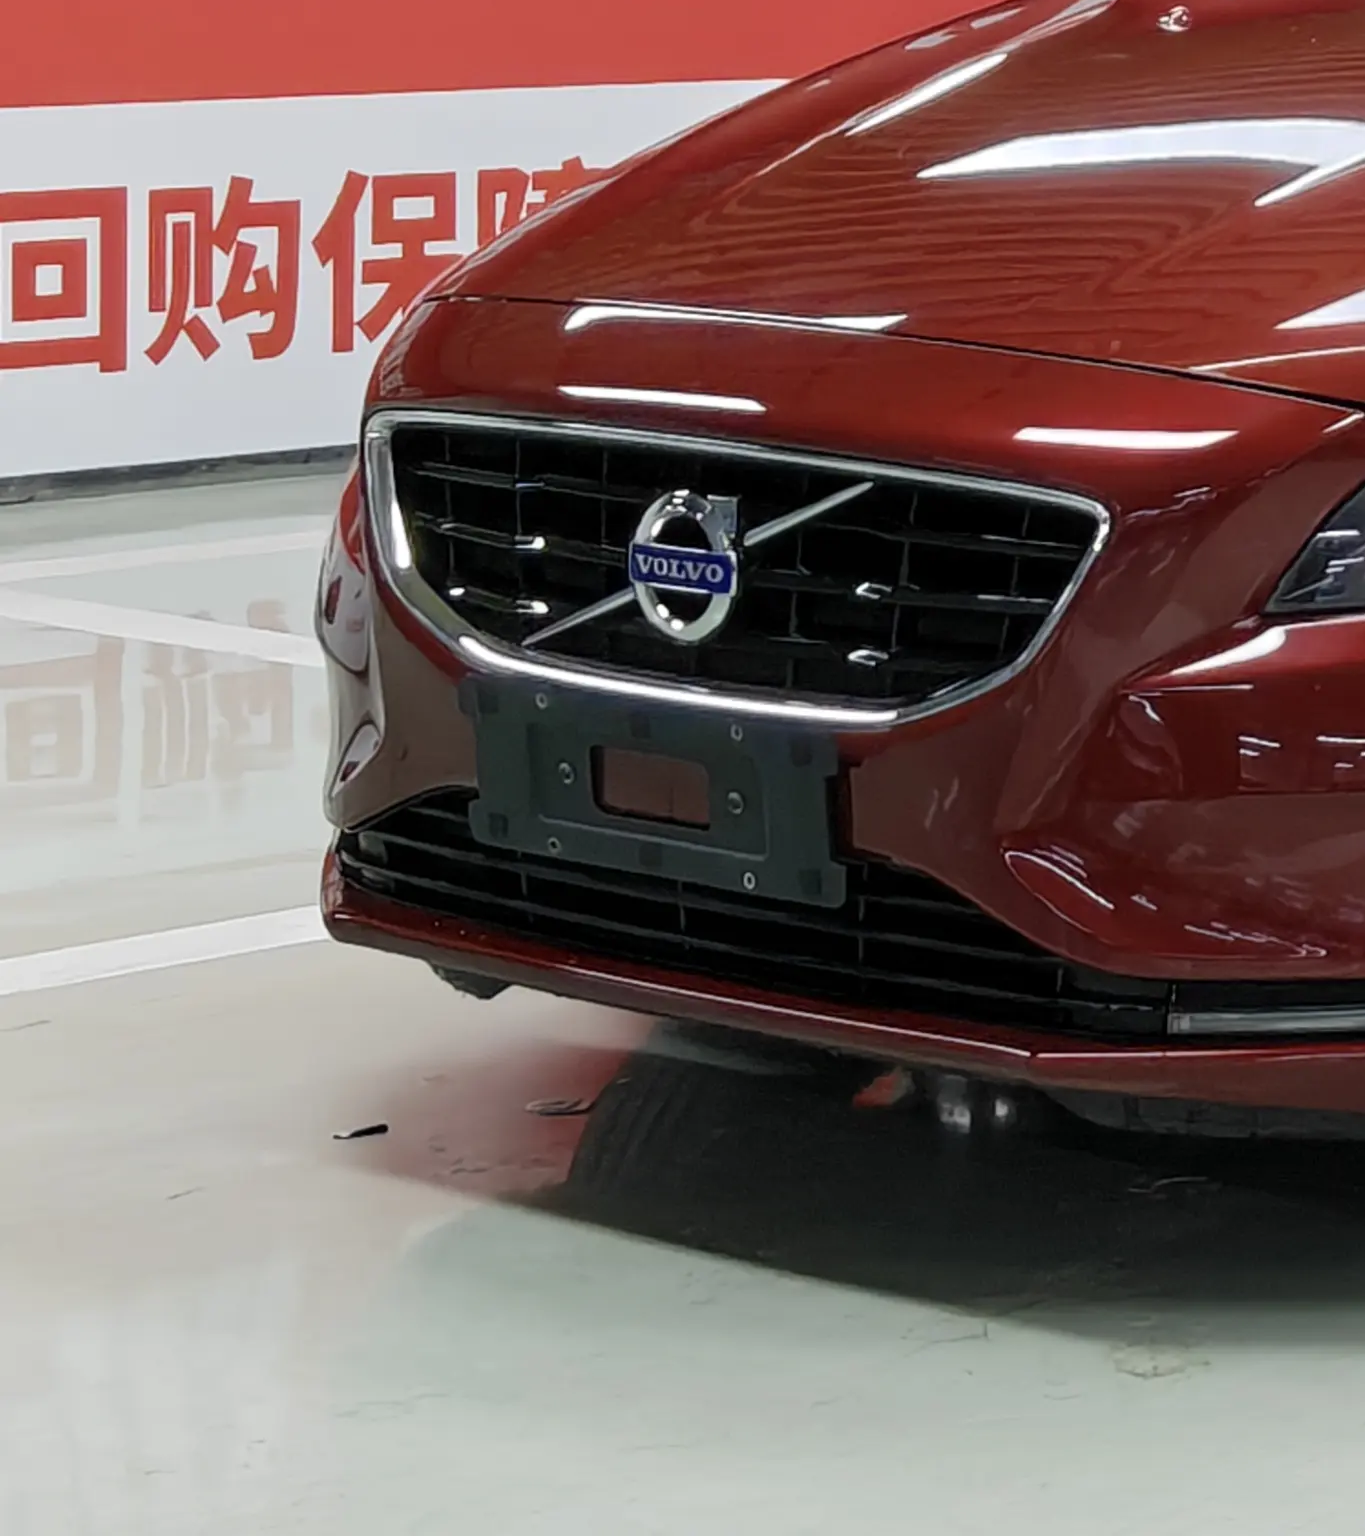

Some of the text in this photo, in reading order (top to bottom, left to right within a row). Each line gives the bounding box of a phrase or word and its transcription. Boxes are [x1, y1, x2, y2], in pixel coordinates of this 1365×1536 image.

[0, 157, 608, 373] 回购保
[634, 553, 725, 584] VOLVO
